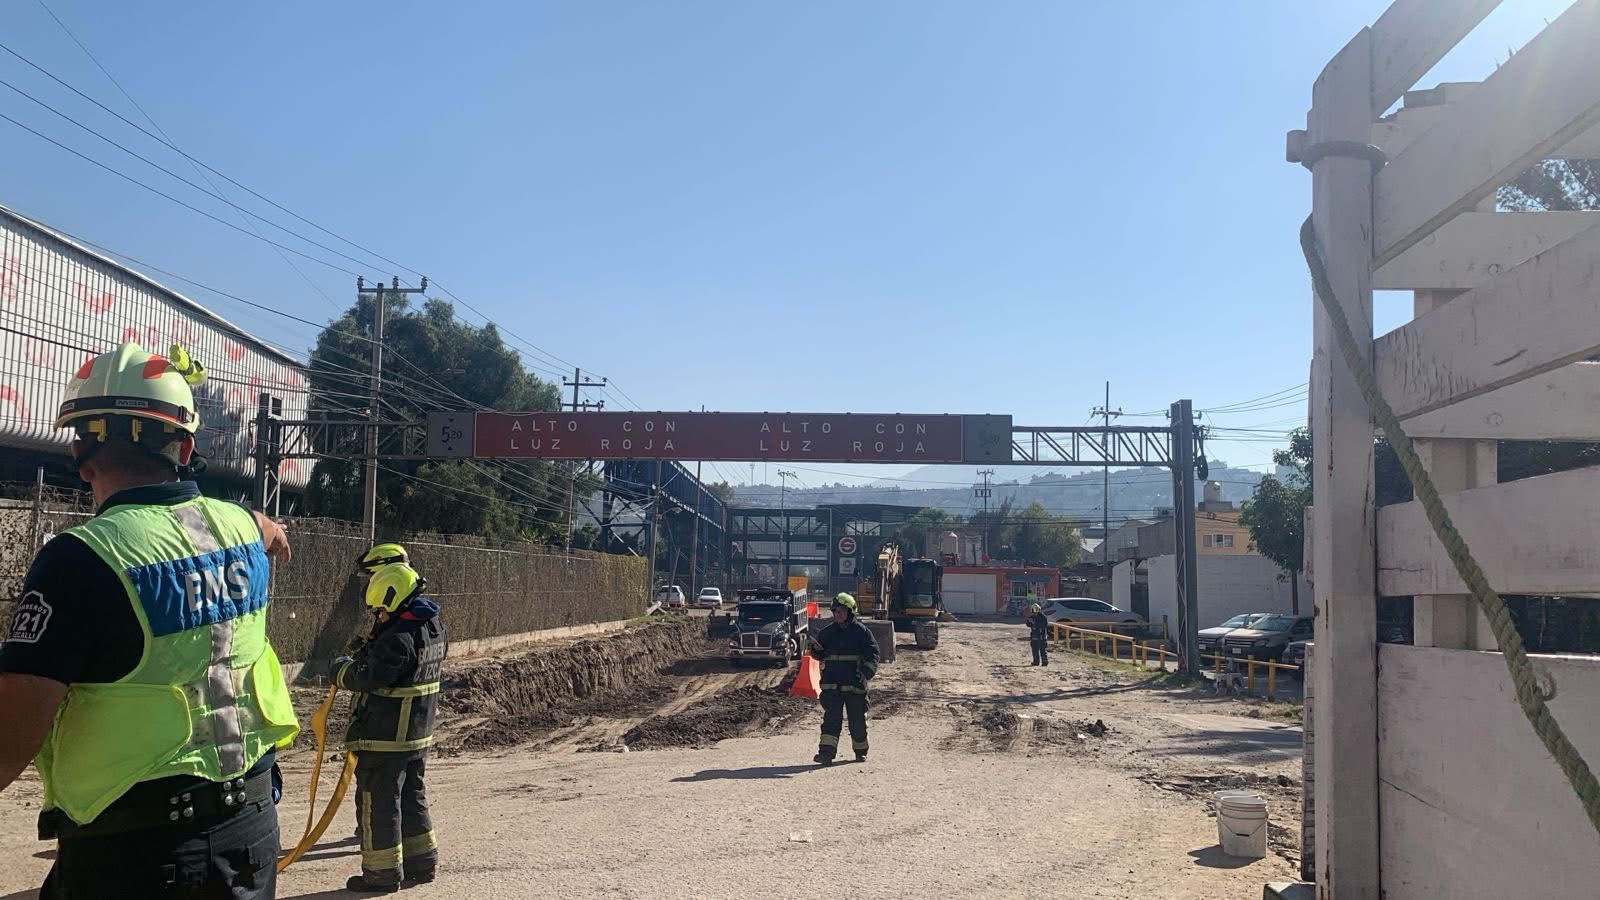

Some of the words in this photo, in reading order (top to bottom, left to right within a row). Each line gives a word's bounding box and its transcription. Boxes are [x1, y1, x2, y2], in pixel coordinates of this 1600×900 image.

[512, 420, 577, 431] ALTO
[622, 421, 676, 432] CON
[760, 422, 832, 434] ALTO
[876, 423, 926, 434] CON
[511, 439, 561, 450] LUZ
[601, 439, 675, 450] ROJA
[760, 440, 812, 452] LUZ
[853, 441, 926, 453] ROJA
[185, 560, 249, 613] EMS
